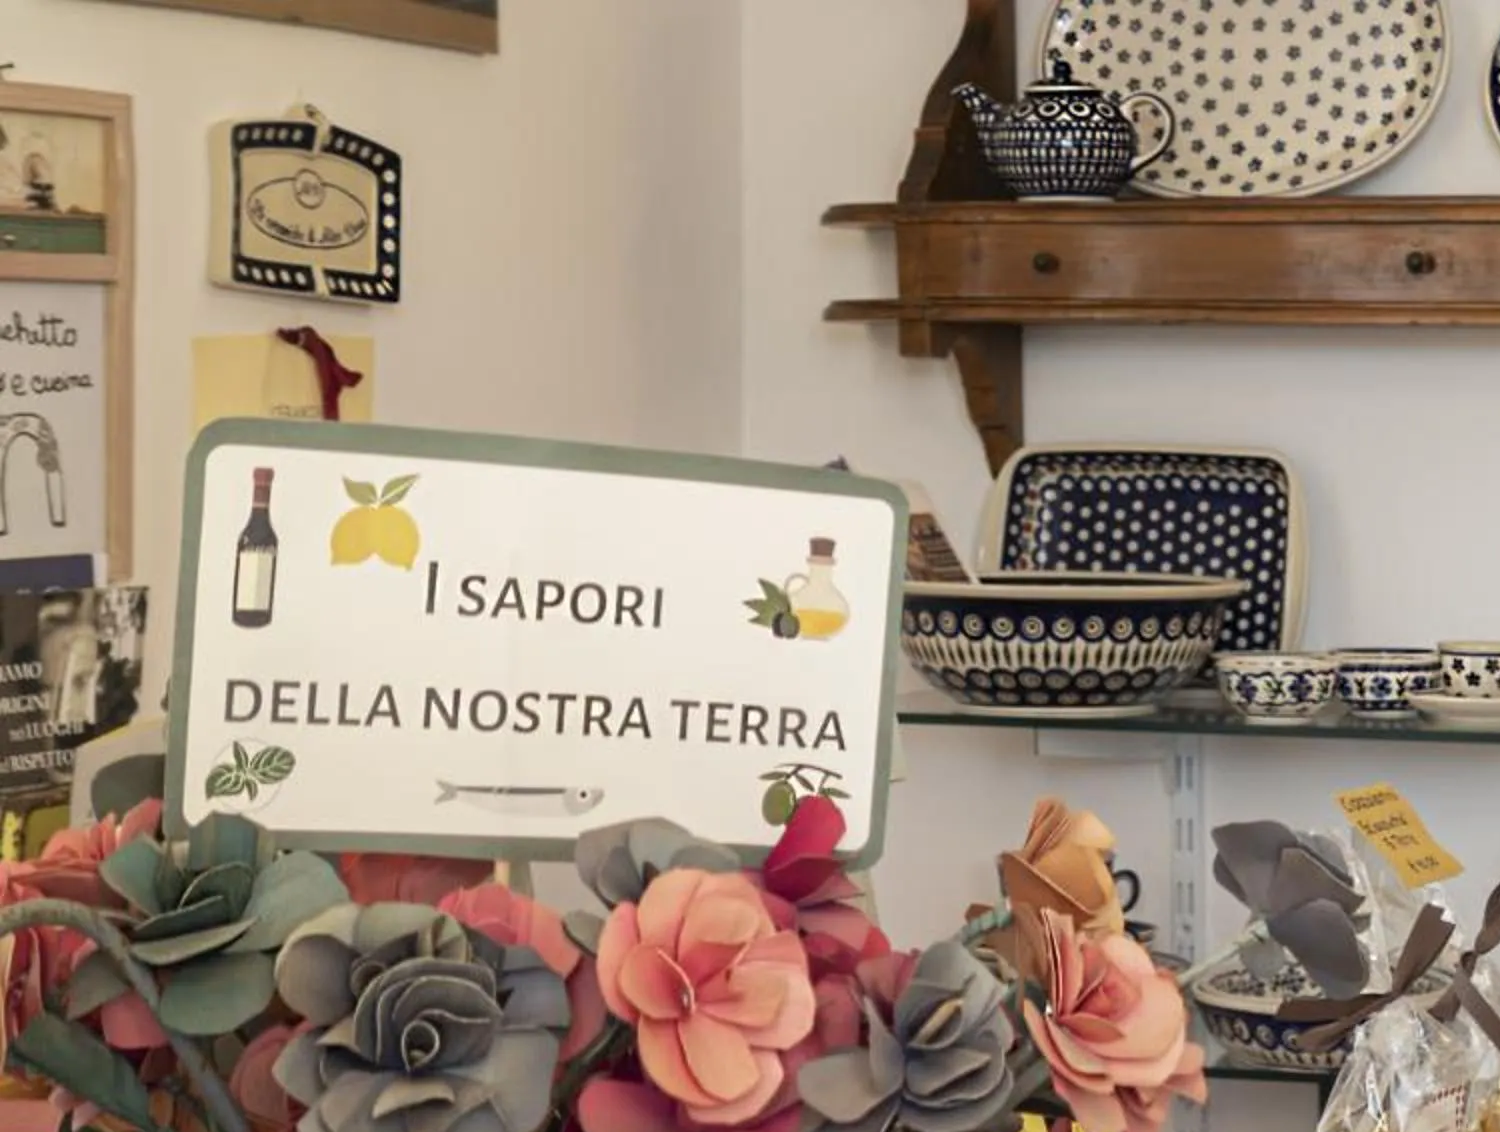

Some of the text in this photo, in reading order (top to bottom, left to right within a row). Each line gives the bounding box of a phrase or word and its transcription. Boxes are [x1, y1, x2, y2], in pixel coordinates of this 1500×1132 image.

[426, 561, 664, 628] I SAPORI
[224, 679, 847, 751] DELLA NOSTRA TERRA
